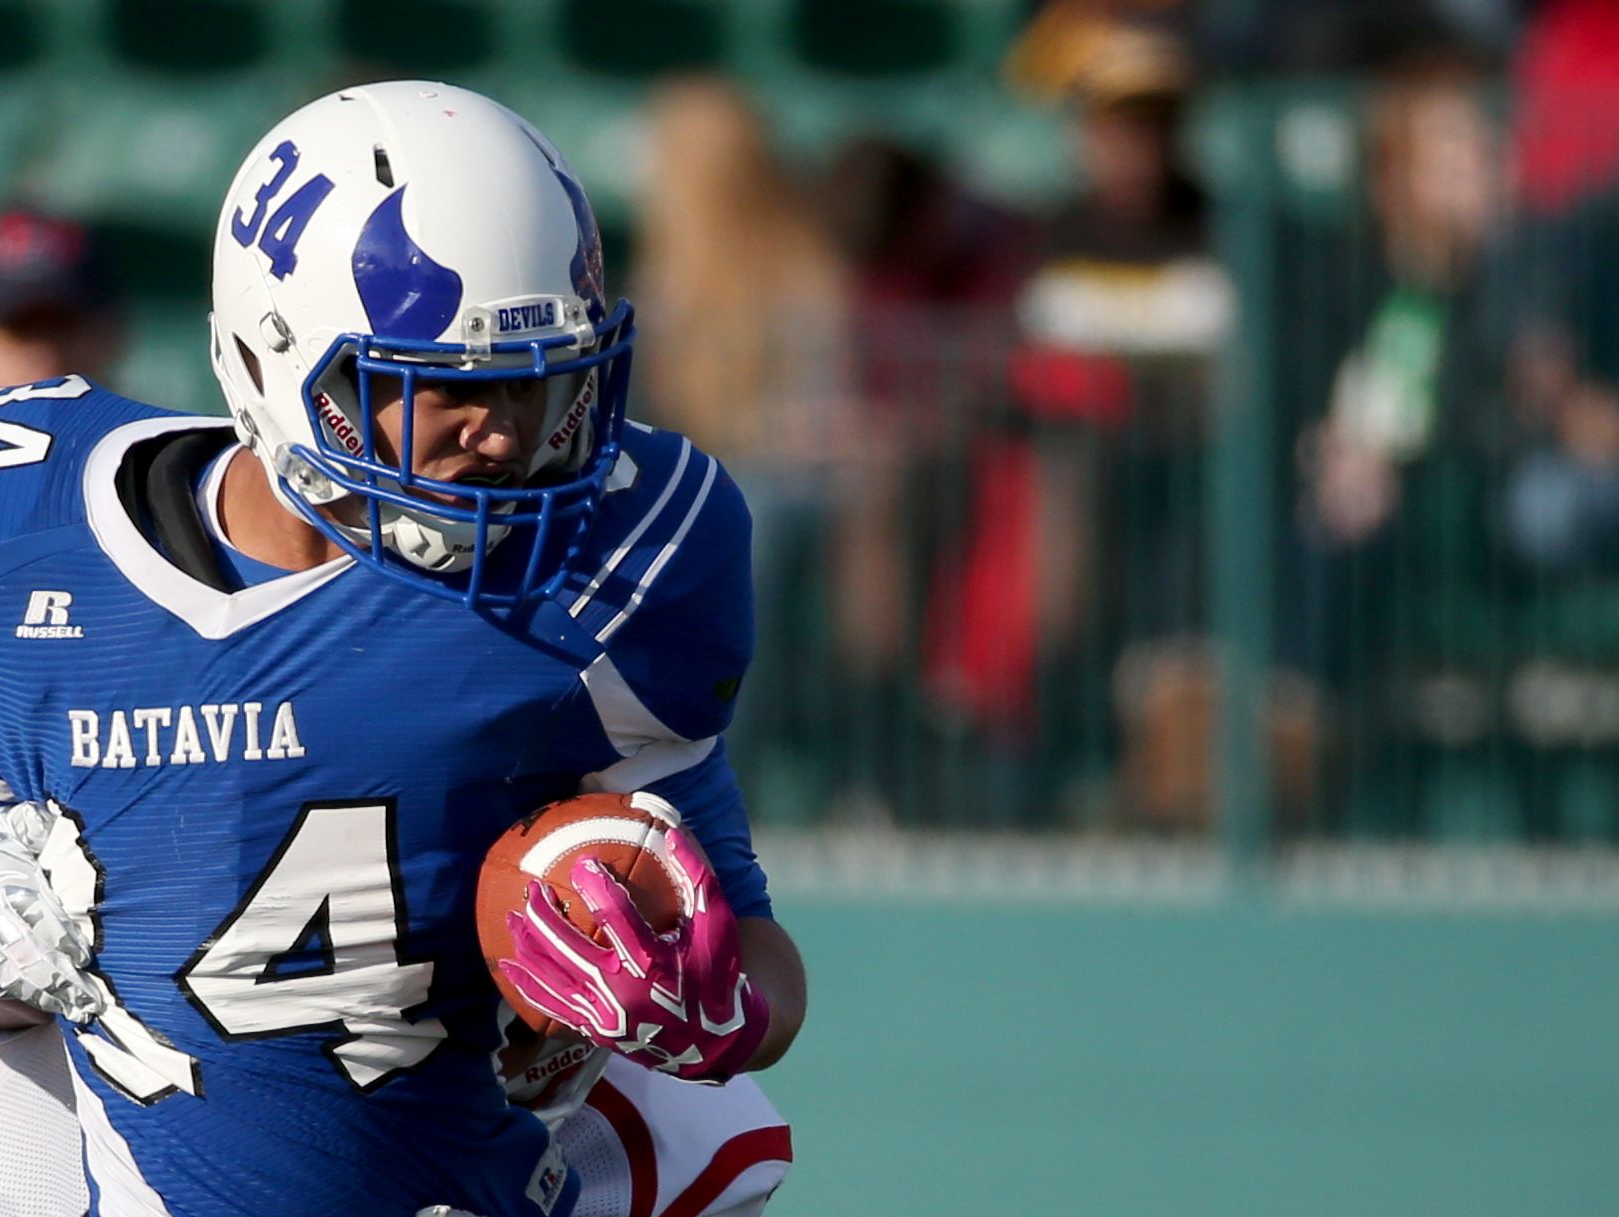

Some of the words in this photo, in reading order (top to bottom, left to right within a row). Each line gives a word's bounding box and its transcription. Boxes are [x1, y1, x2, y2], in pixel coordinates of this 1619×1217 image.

[231, 139, 336, 283] 34
[497, 302, 555, 332] DEVILS
[313, 391, 365, 459] Riddel
[15, 625, 85, 639] RUSSELL
[24, 589, 73, 625] R
[67, 701, 306, 769] BATAVIA
